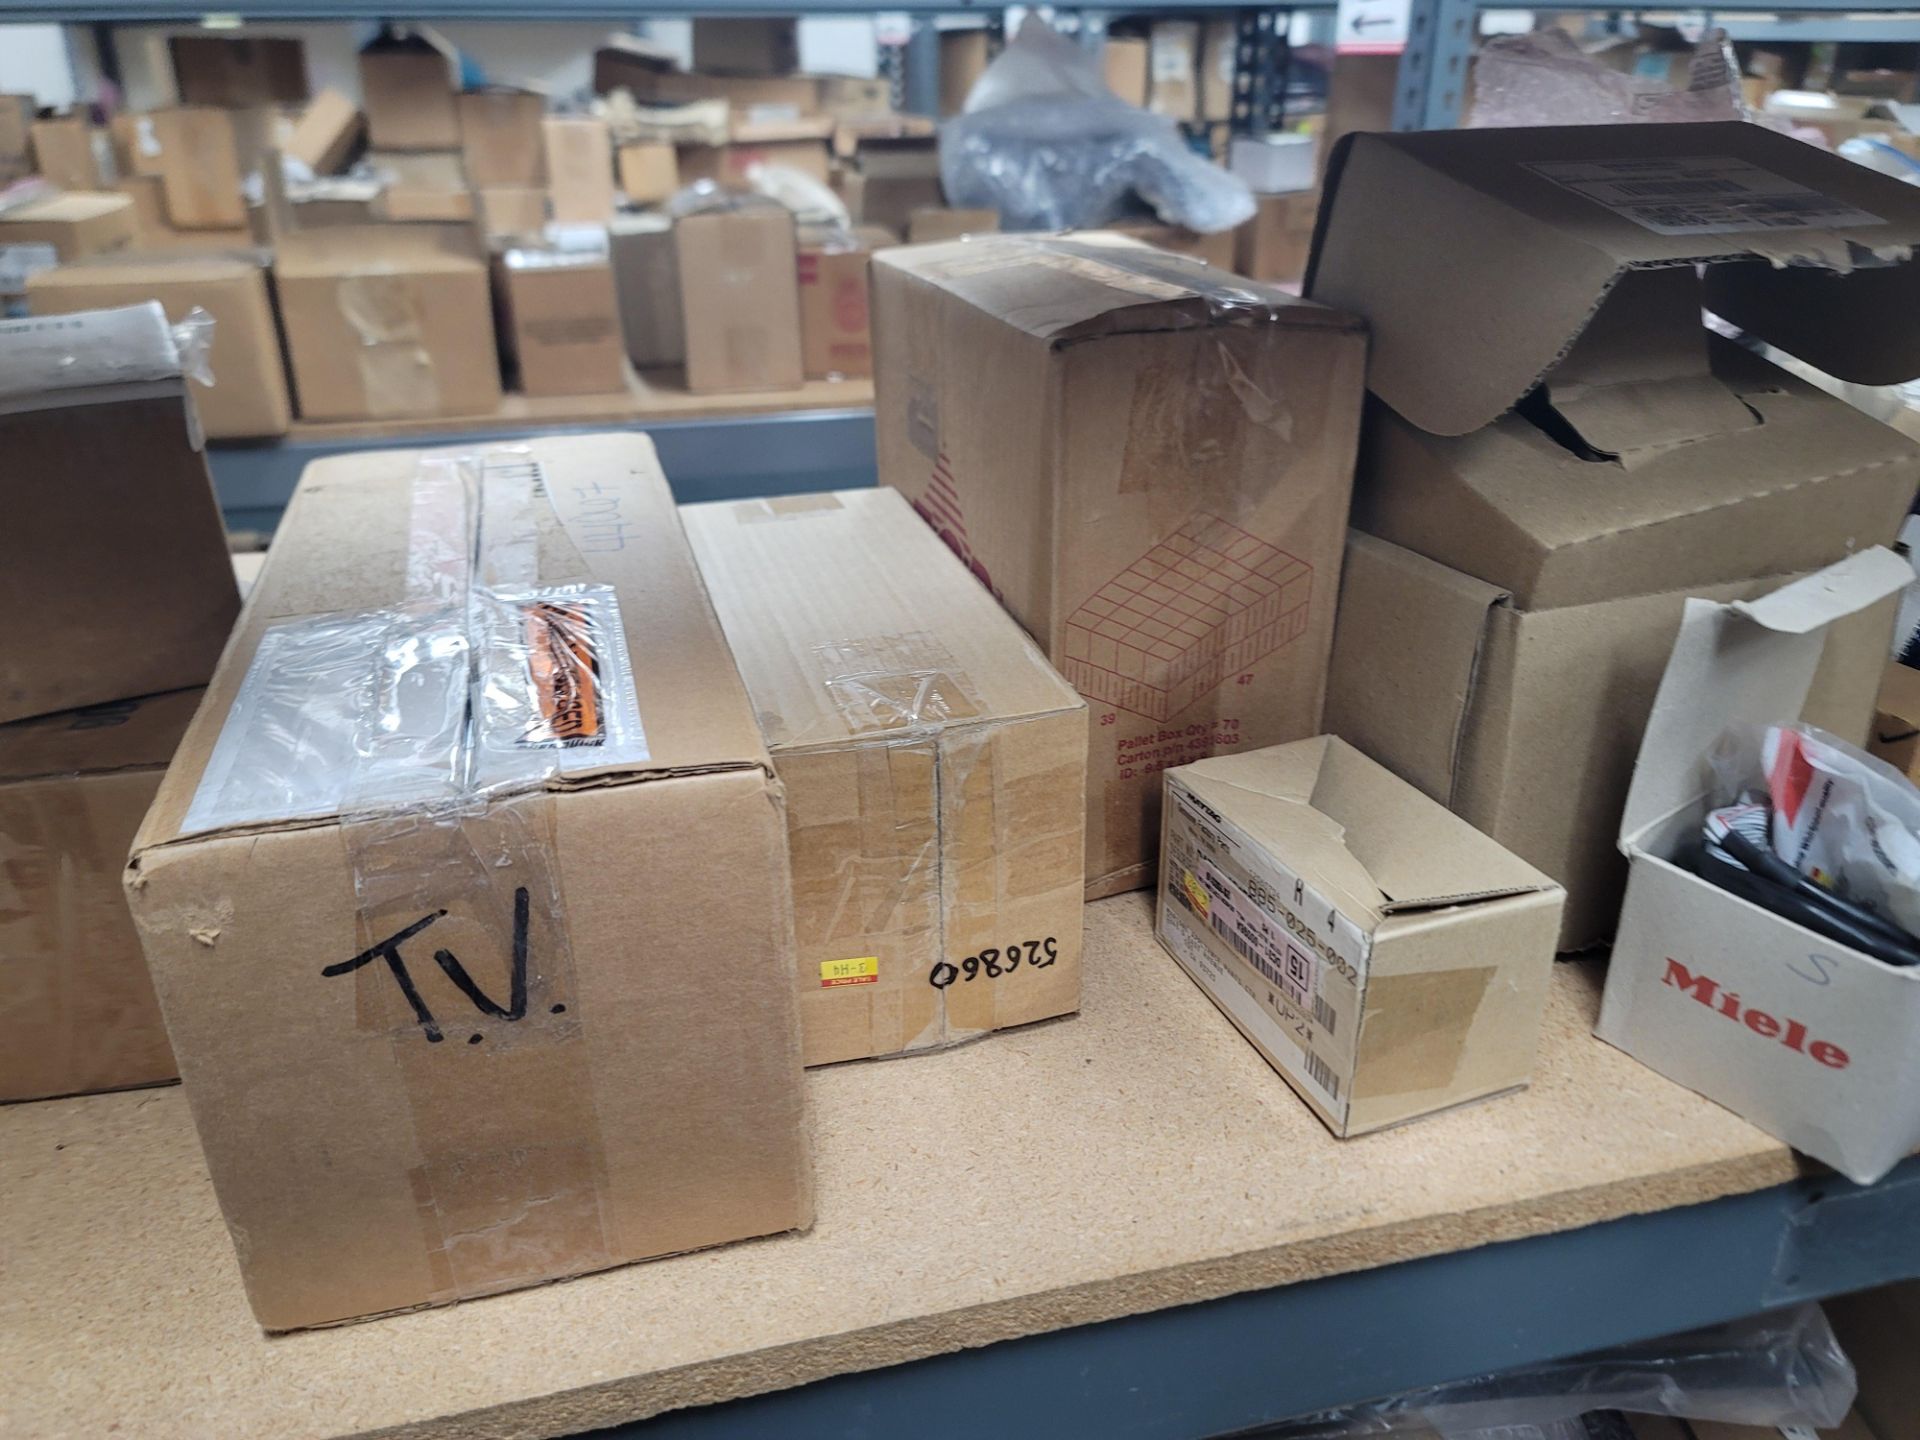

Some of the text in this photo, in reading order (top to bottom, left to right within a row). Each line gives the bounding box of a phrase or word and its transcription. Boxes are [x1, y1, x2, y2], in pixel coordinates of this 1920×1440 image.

[1237, 674, 1254, 686] 47
[1100, 714, 1116, 726] 39
[1118, 734, 1155, 751] Pallet
[1158, 729, 1182, 742] Box
[1186, 724, 1207, 737] Qty
[1118, 748, 1160, 765] Carton
[1163, 742, 1184, 757] p/n
[1120, 768, 1137, 780] ID:
[1327, 909, 1336, 933] 4
[321, 885, 566, 1046] T.V.
[929, 937, 1058, 990] 526860
[1290, 955, 1304, 981] 15
[1660, 955, 1851, 1071] Miele
